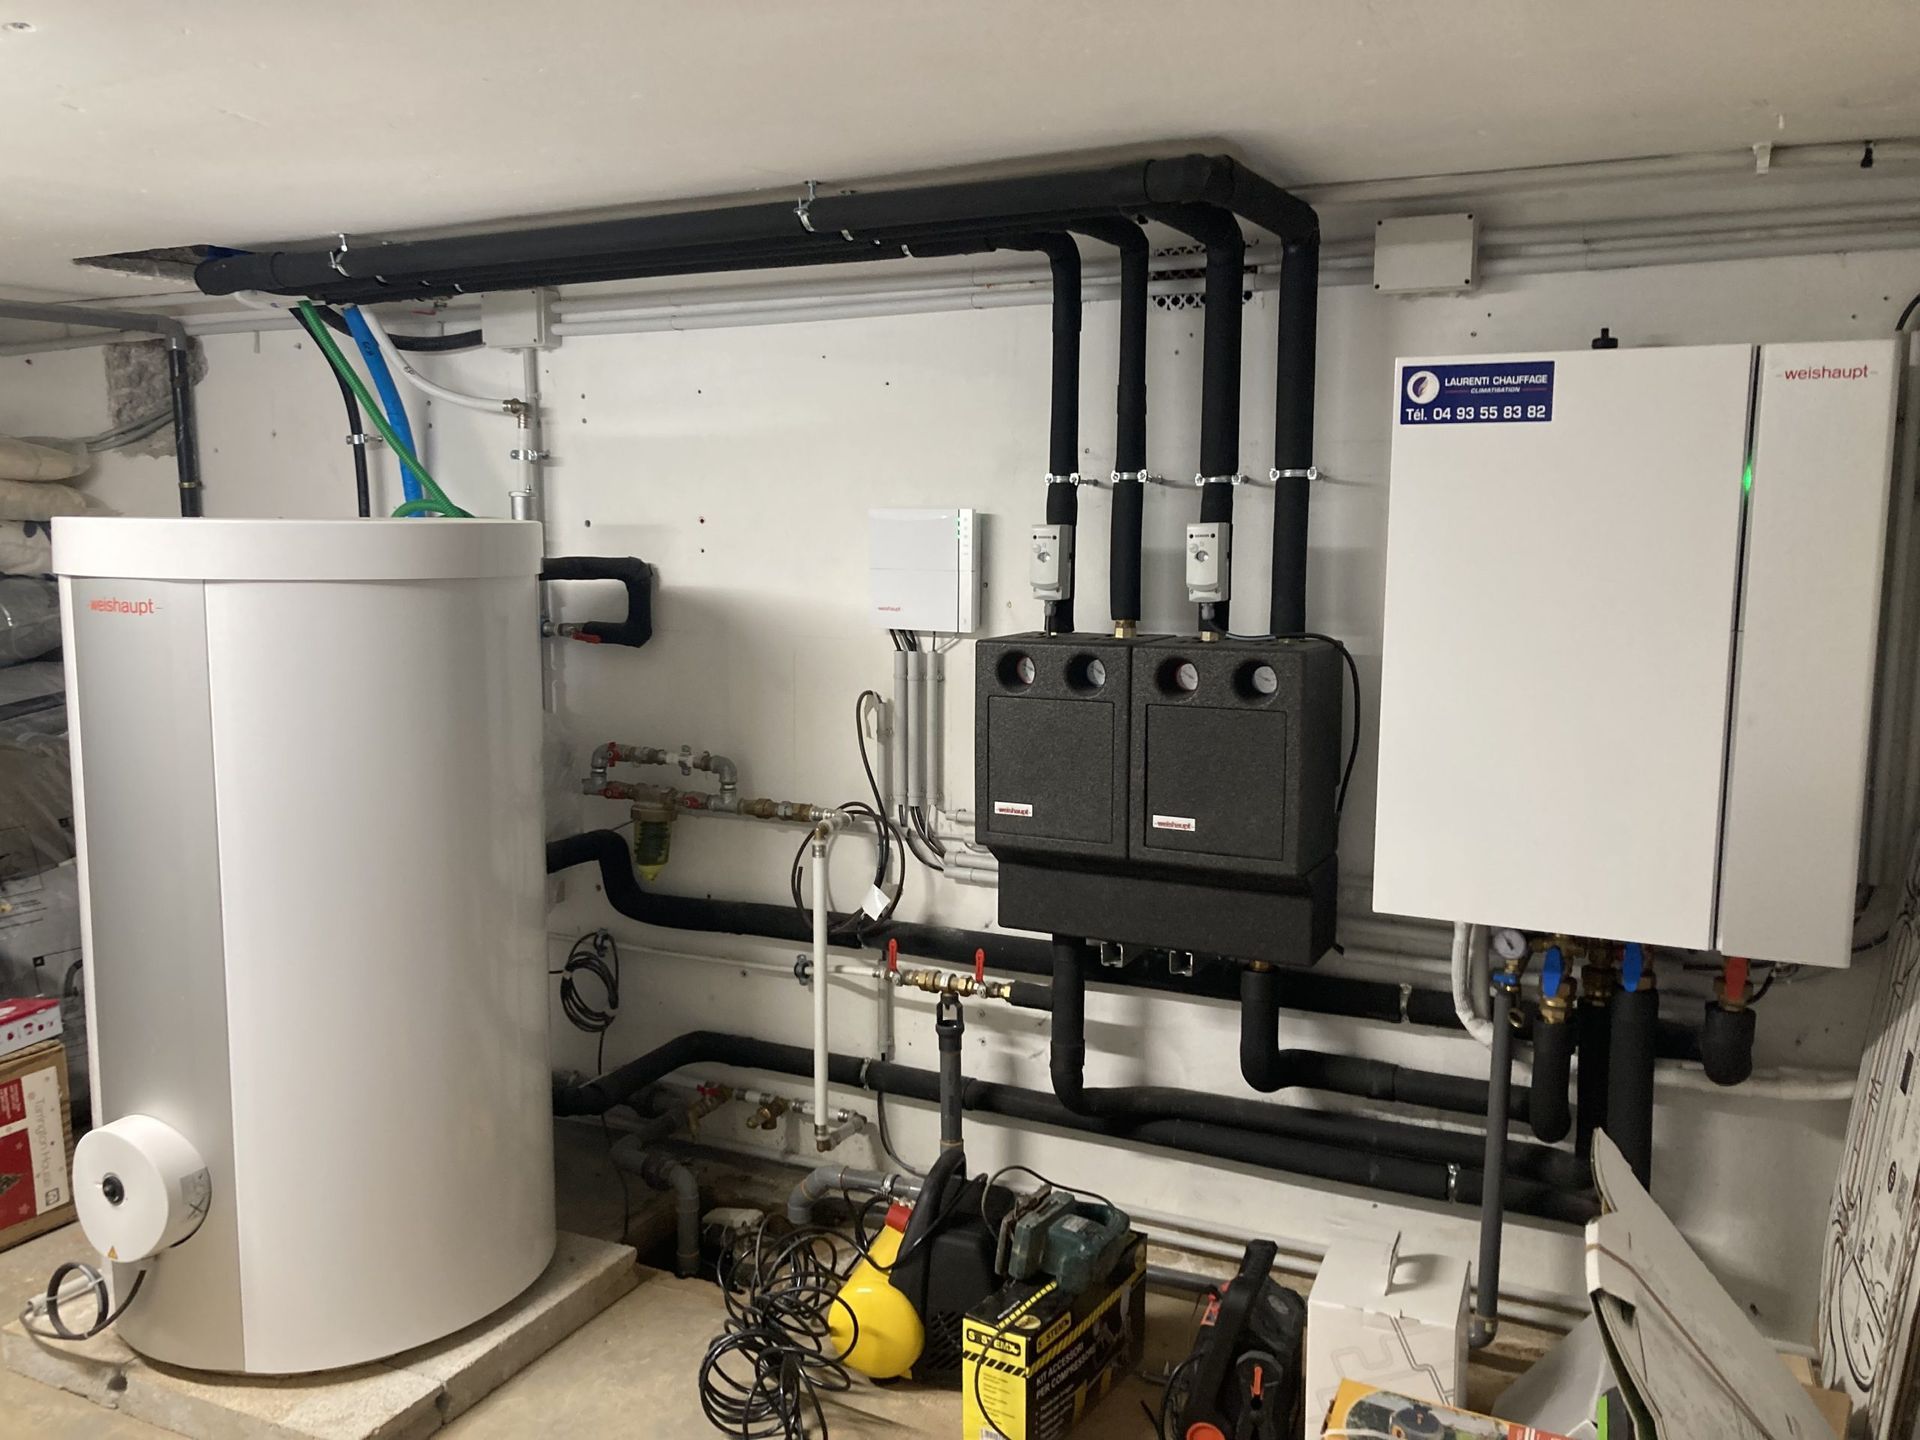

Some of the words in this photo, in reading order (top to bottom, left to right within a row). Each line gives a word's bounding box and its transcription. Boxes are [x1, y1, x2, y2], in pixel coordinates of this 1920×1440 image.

[1784, 364, 1868, 380] weishaupt
[1444, 376, 1490, 387] LAURENTI
[1492, 374, 1548, 386] CHAUFFAGE
[1405, 408, 1428, 421] Tél.
[1433, 407, 1451, 420] 04
[1456, 406, 1475, 419] 93
[1479, 406, 1498, 419] 55
[1503, 405, 1522, 418] 83
[1527, 404, 1546, 418] 82
[89, 598, 154, 616] weishaupt
